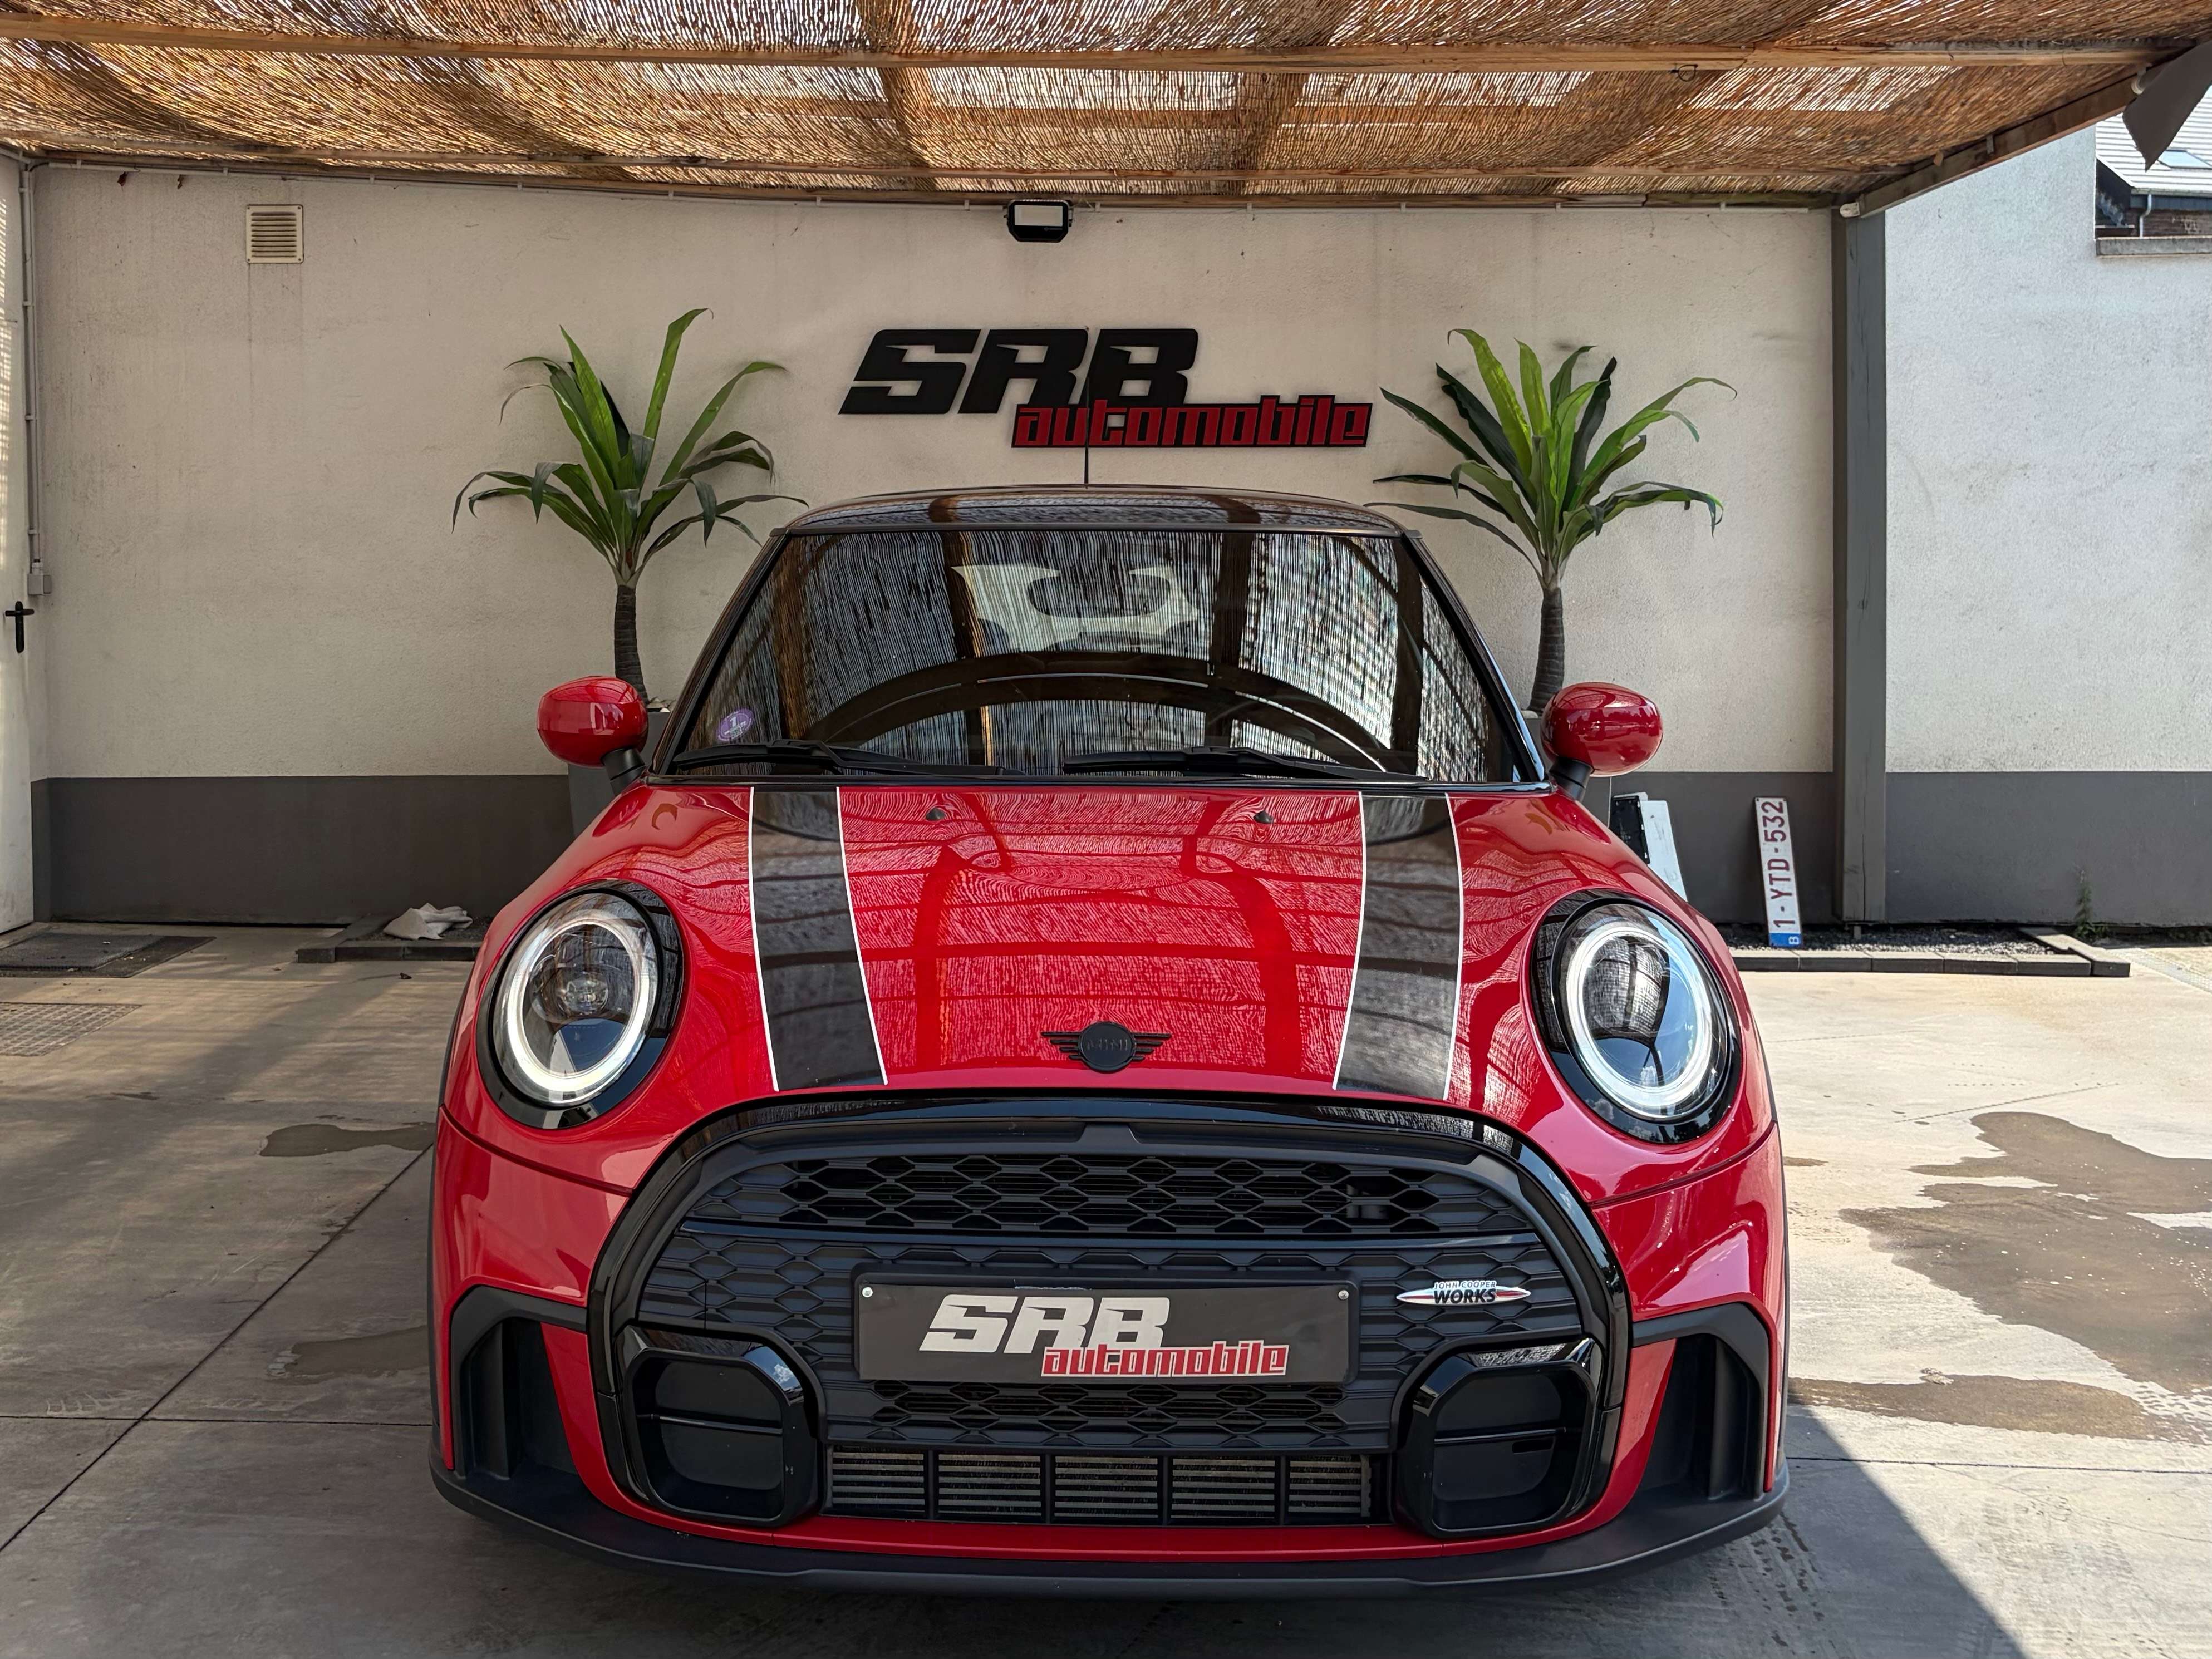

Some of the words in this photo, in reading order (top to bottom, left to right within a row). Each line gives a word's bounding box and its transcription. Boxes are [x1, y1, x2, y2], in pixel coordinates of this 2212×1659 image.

[839, 328, 1198, 414] SRB
[1011, 395, 1373, 447] automobile
[1761, 801, 1796, 928] 1-YTD-532
[1788, 936, 1800, 945] B
[1088, 1038, 1129, 1051] MINI
[1434, 1289, 1496, 1304] WORKS
[919, 1294, 1171, 1353] SRB
[1041, 1341, 1290, 1377] automobile
